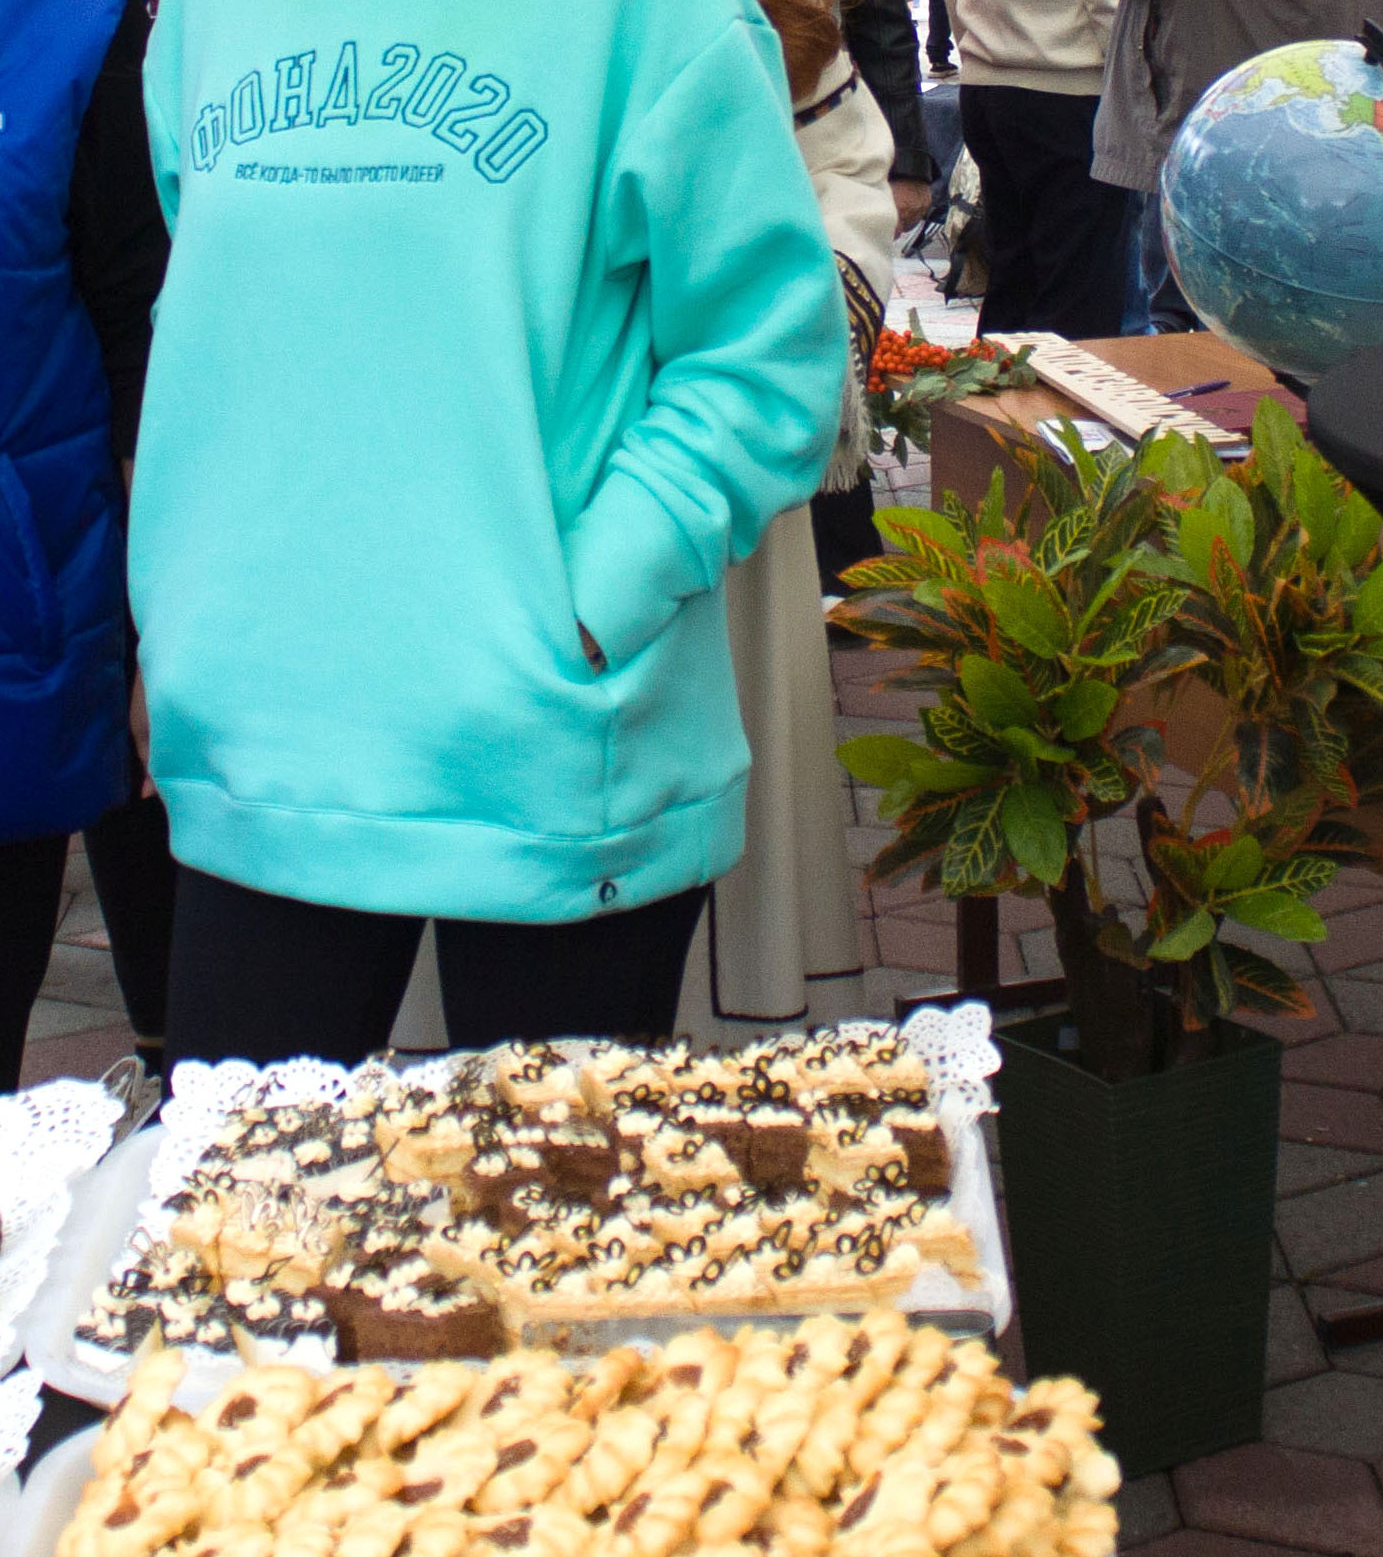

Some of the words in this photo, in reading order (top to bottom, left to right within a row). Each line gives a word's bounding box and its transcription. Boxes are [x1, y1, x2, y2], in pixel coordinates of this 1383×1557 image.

[235, 162, 259, 180] ВСЁ
[260, 164, 318, 184] КОГДА-ТО
[319, 166, 353, 184] БЫЛО
[354, 165, 398, 183] ПРОСТО
[400, 163, 445, 183] ИДЕЕЙ
